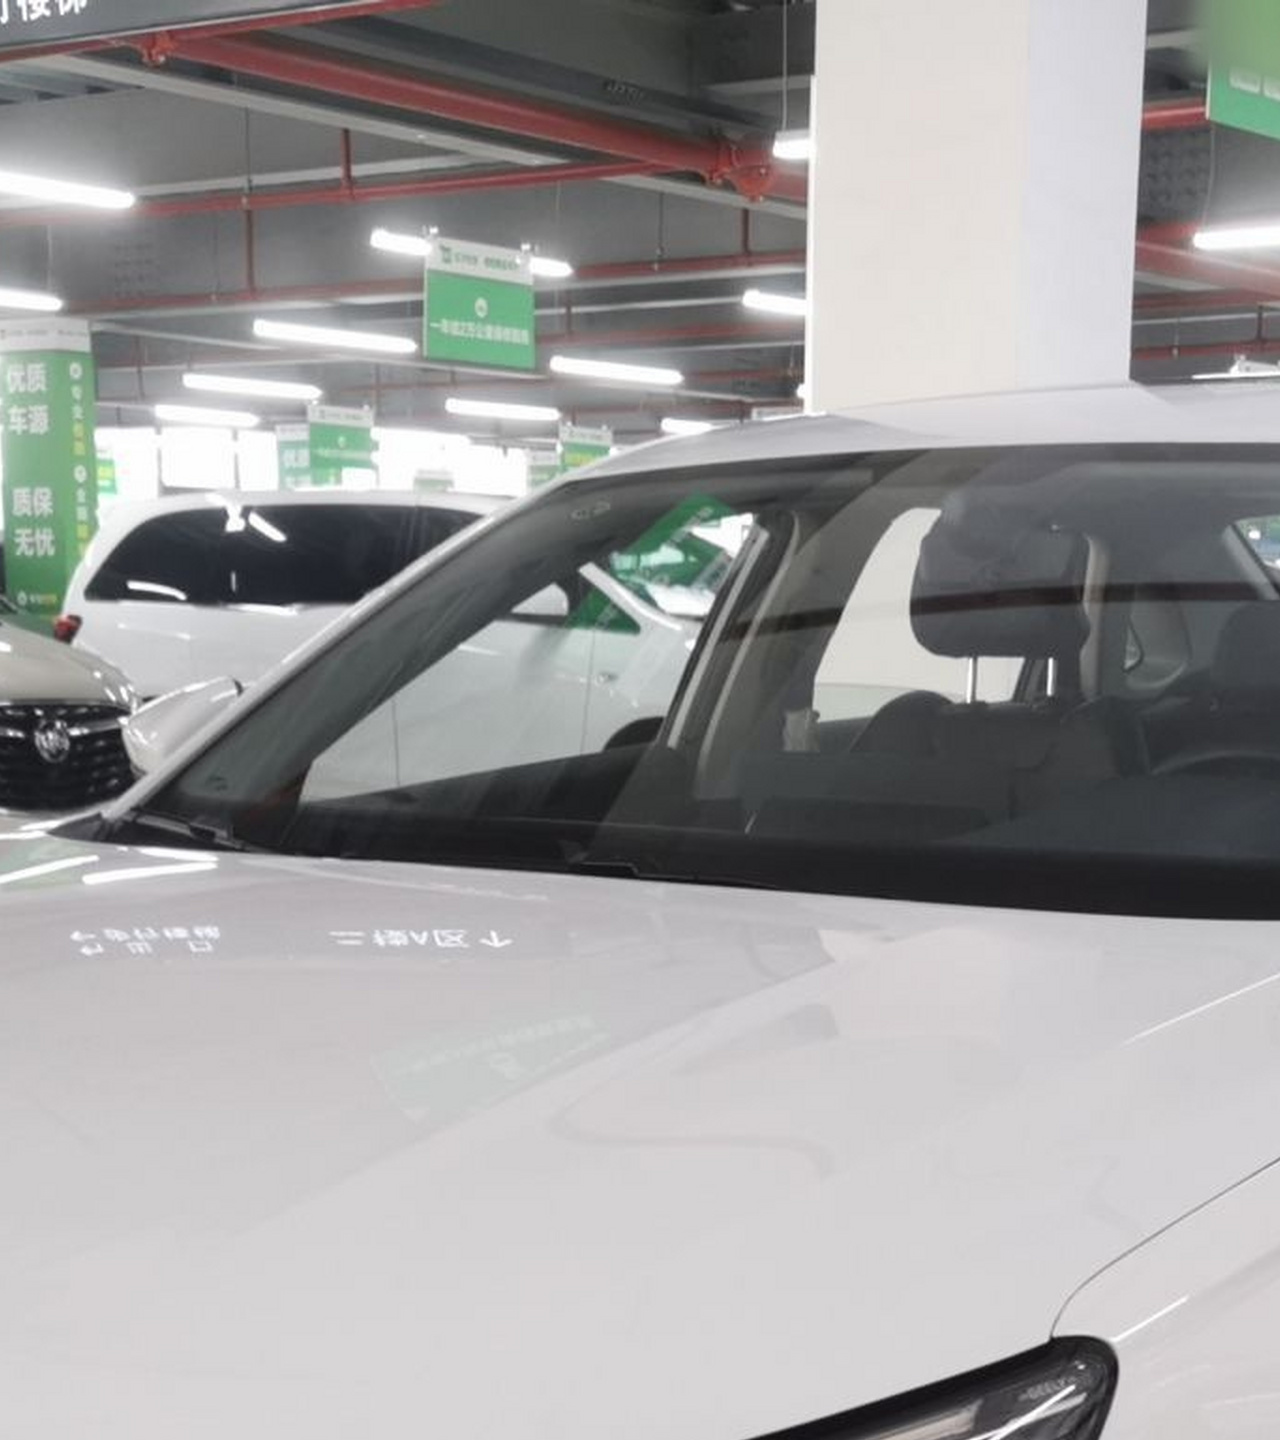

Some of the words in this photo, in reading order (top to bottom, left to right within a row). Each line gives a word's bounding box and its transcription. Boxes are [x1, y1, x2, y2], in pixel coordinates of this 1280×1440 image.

[8, 403, 49, 436] 车源
[11, 486, 54, 519] 质保
[14, 527, 56, 558] 无忧
